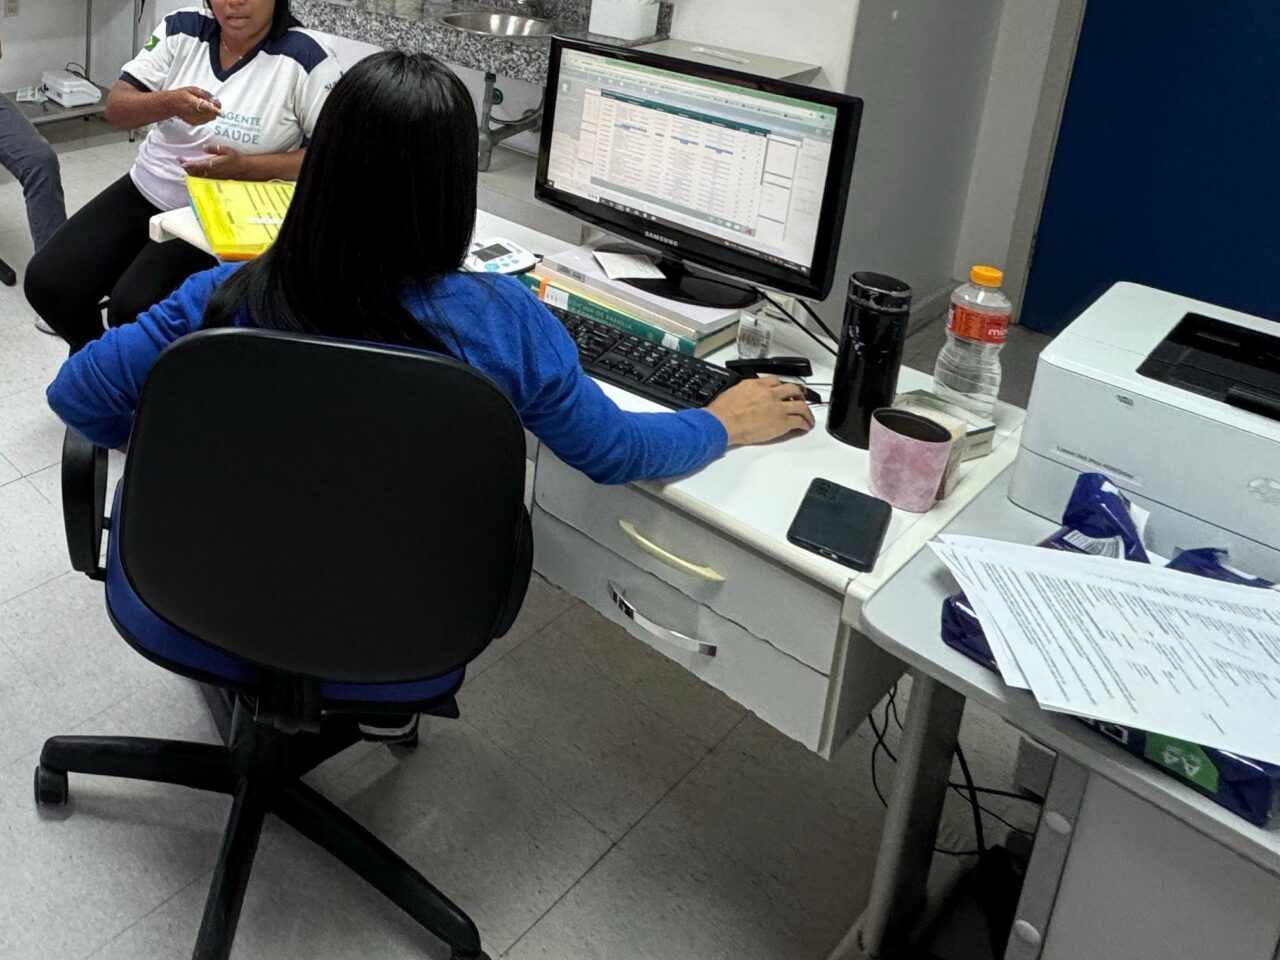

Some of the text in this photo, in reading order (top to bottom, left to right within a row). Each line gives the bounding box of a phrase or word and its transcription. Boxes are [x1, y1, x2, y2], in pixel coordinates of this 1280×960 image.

[220, 111, 262, 126] GENTE
[214, 125, 260, 145] SAÚDE
[644, 230, 679, 247] SAMSUNG
